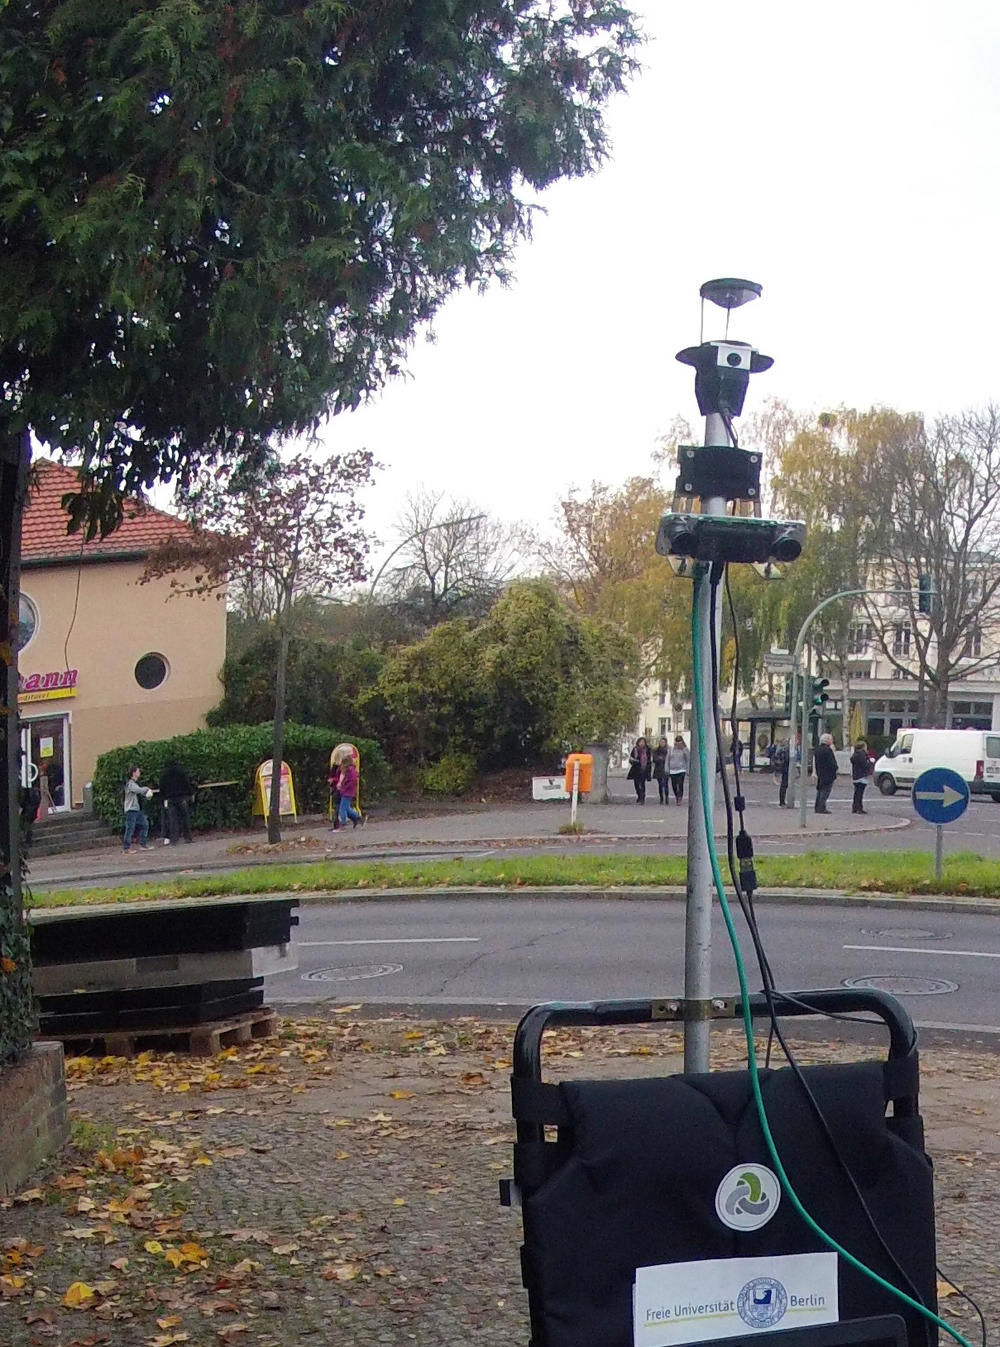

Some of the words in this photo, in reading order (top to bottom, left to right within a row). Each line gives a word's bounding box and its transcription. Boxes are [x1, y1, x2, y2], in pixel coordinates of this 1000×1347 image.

[18, 669, 78, 690] ann
[646, 1306, 671, 1322] Freie
[674, 1299, 735, 1318] Universität
[790, 1294, 826, 1307] Berlin
